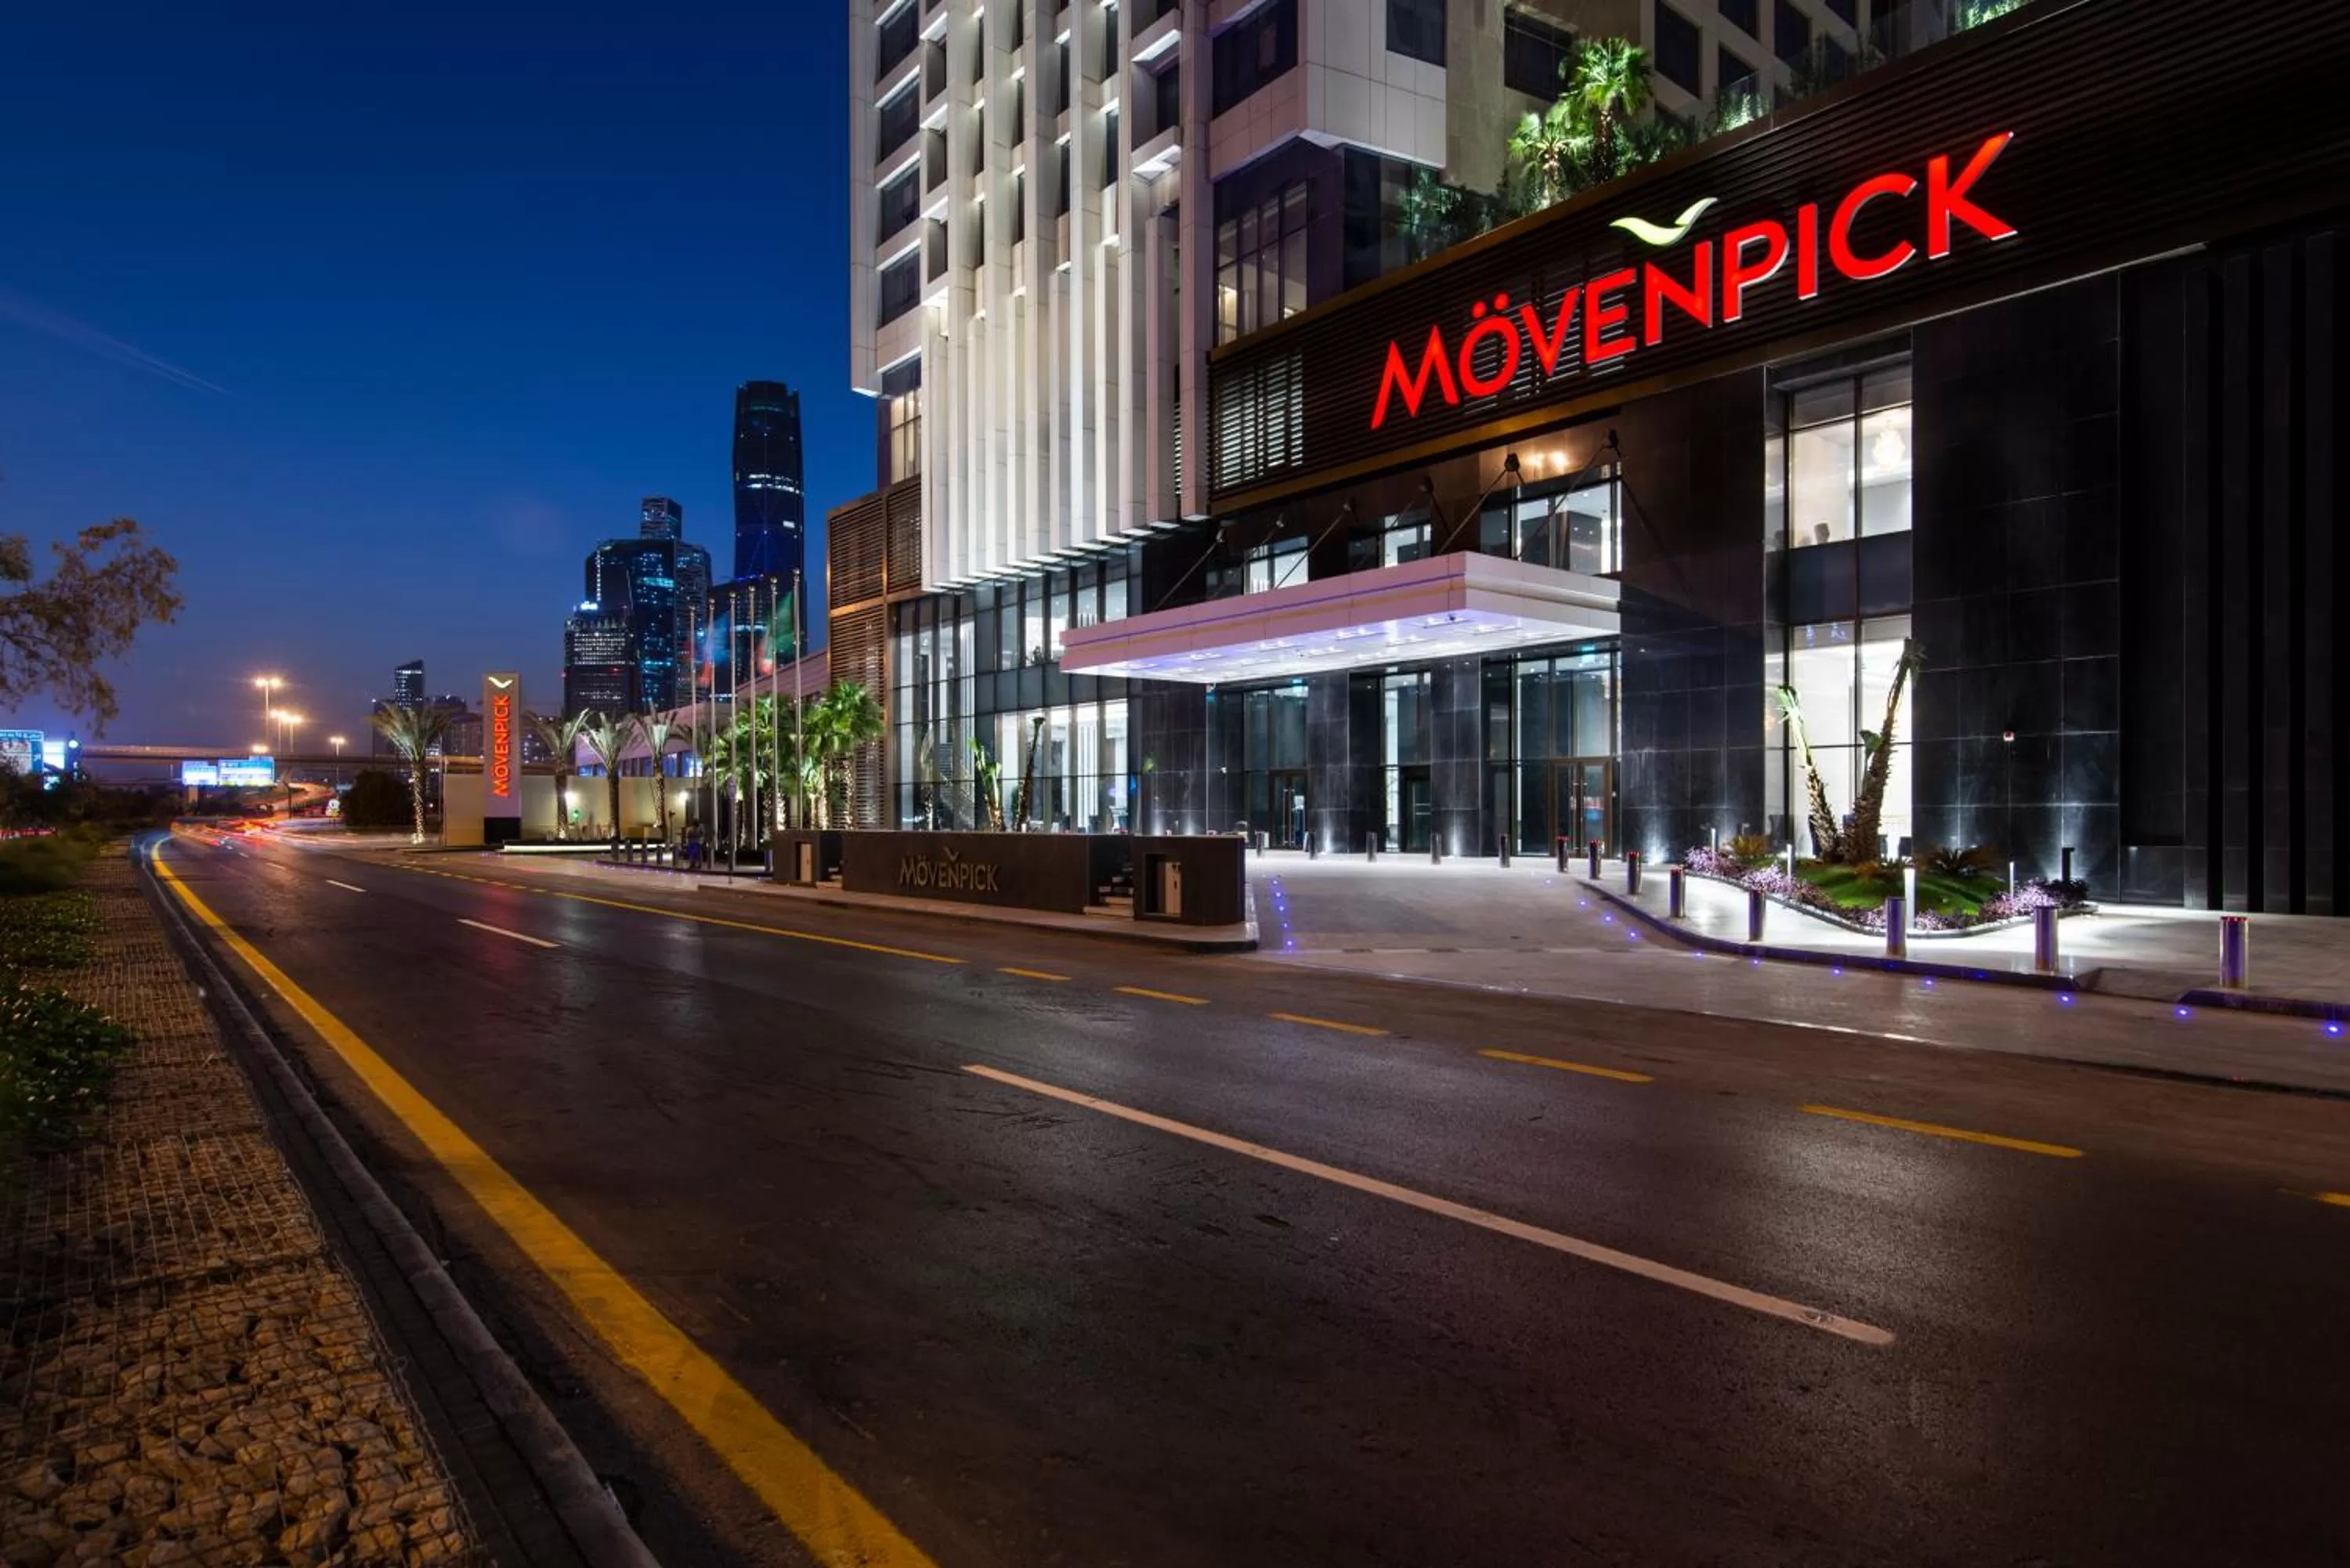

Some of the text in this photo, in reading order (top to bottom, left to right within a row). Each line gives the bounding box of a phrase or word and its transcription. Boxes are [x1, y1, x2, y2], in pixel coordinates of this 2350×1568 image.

[1370, 131, 2017, 430] MÖVENPICK
[490, 694, 511, 797] MÖVENPICK
[899, 854, 1000, 891] MÖVENPICK
